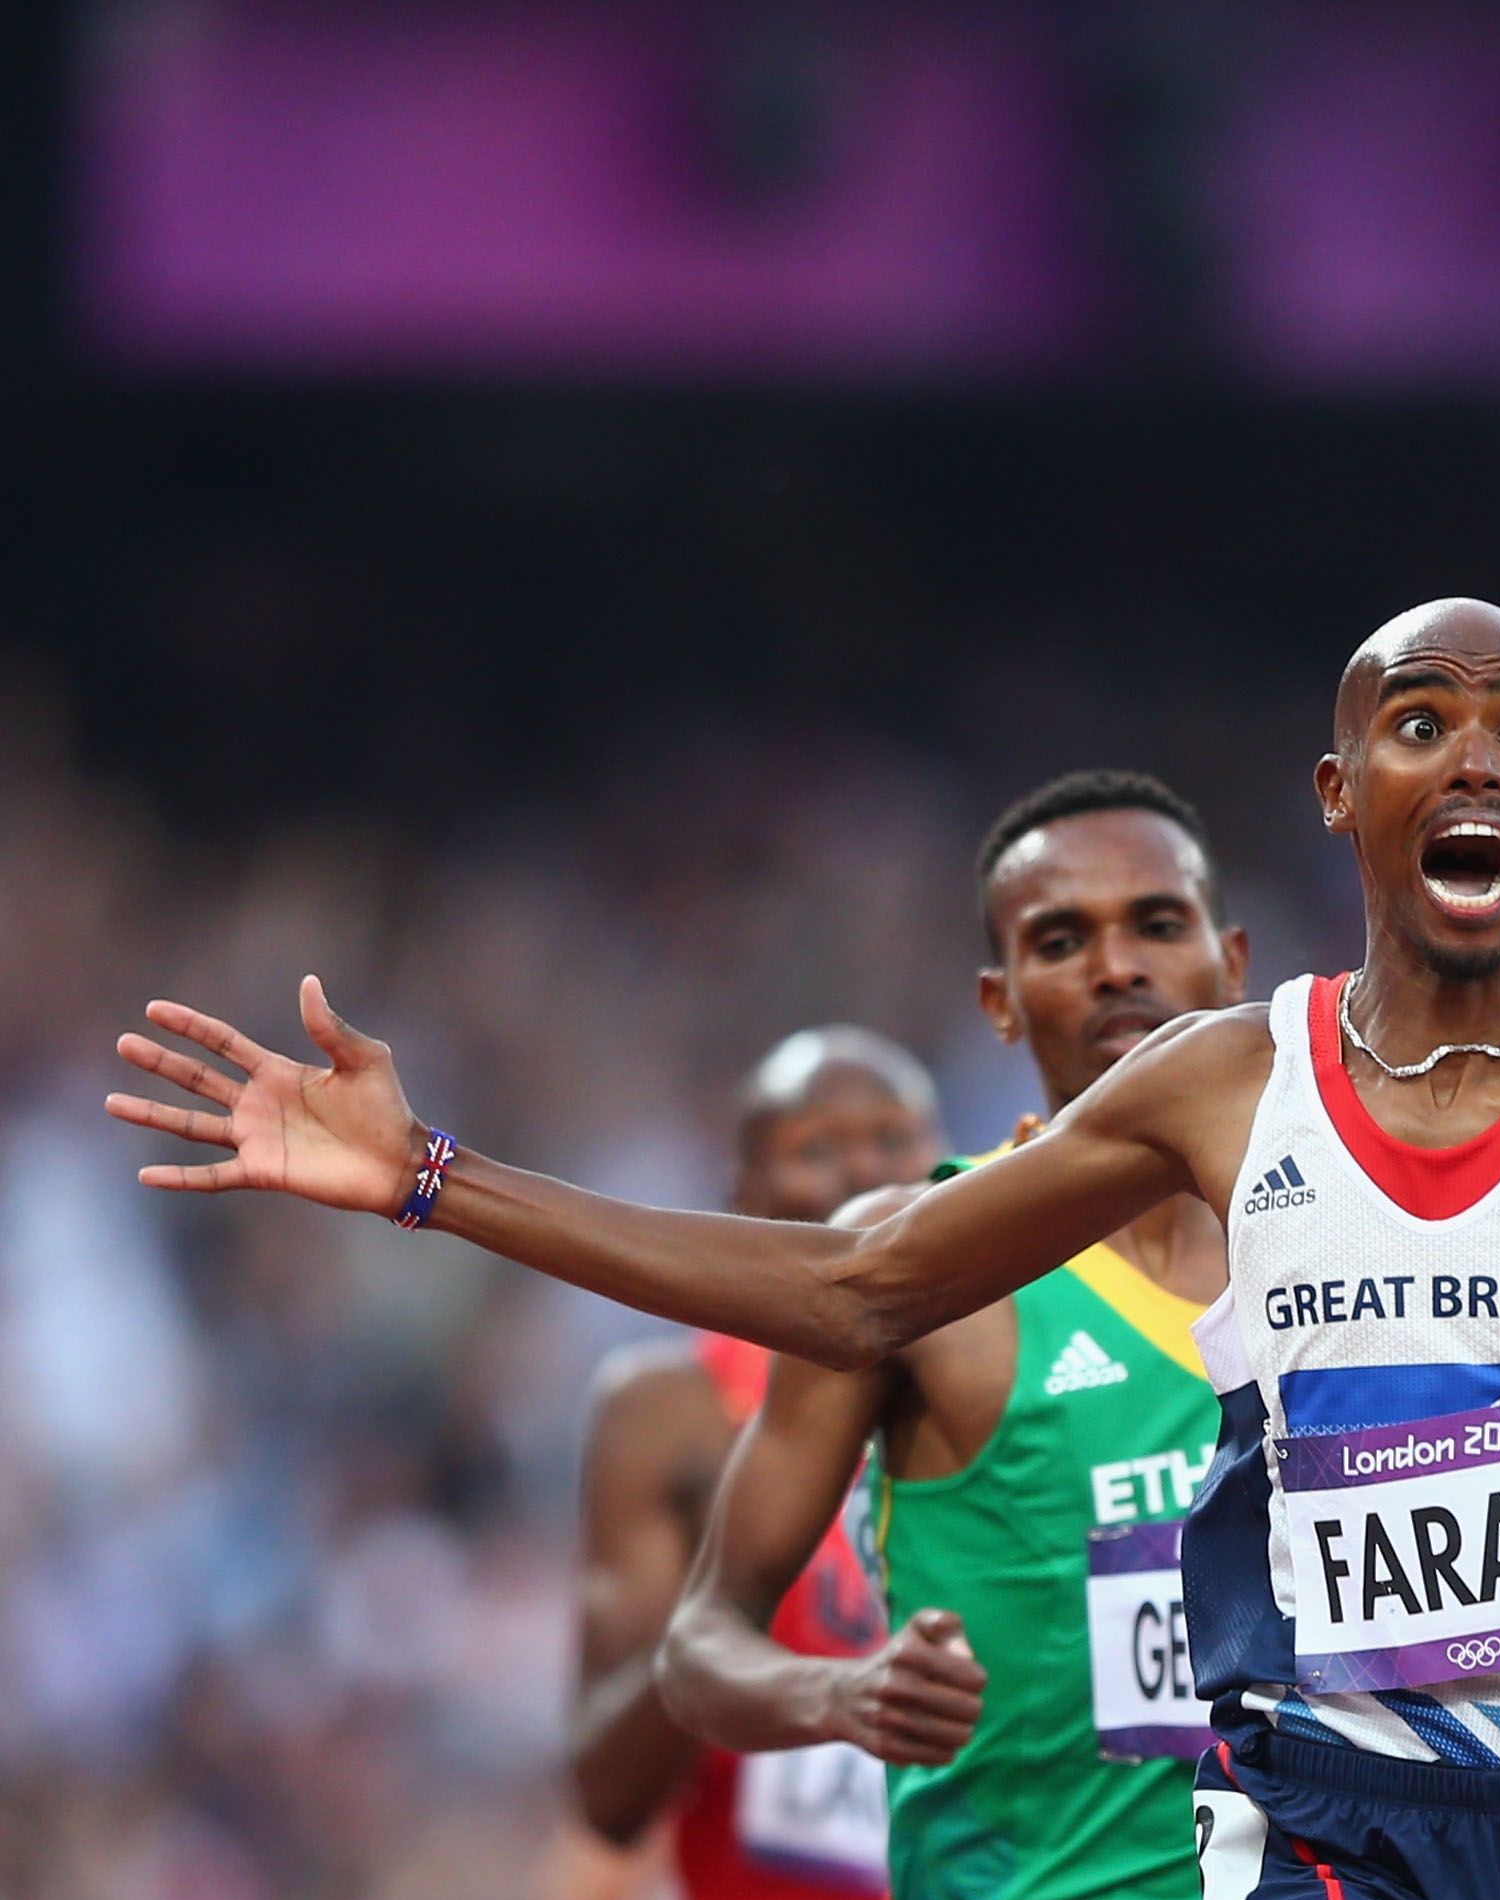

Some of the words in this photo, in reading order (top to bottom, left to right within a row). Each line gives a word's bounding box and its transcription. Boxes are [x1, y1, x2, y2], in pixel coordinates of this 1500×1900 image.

[1244, 1188, 1317, 1215] adidas
[1265, 1275, 1415, 1331] GREAT
[1043, 1361, 1129, 1395] adidas
[1342, 1433, 1456, 1477] London
